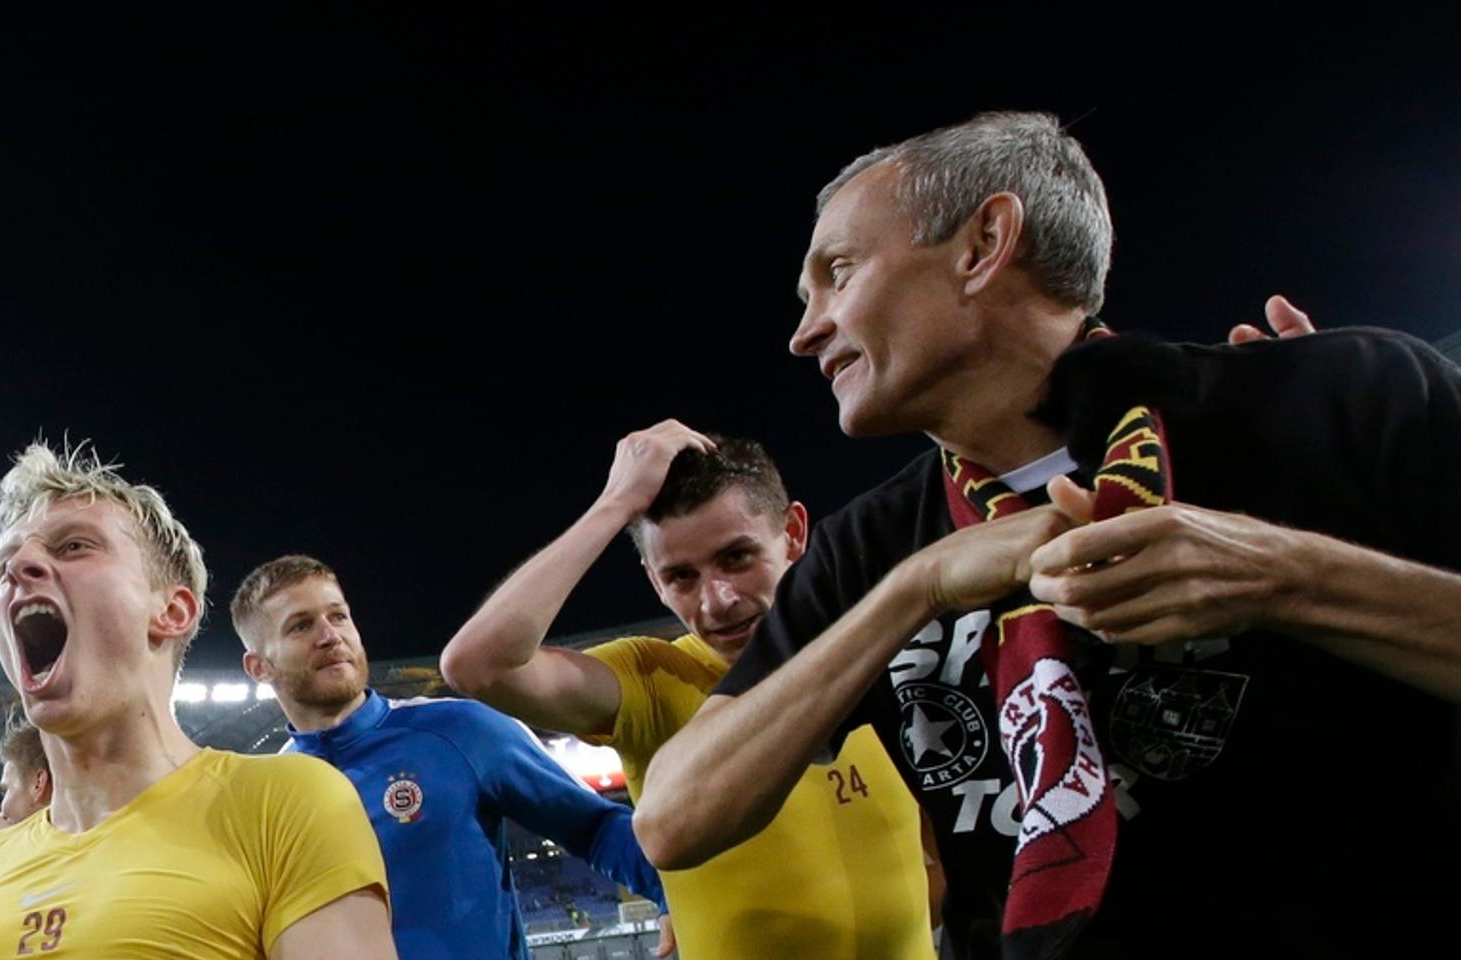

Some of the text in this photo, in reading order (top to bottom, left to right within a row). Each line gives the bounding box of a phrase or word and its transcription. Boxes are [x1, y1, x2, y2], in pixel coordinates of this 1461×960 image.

[943, 693, 981, 732] CLUB
[827, 764, 868, 804] 24
[921, 754, 978, 786] ARTA
[17, 908, 67, 956] 29
